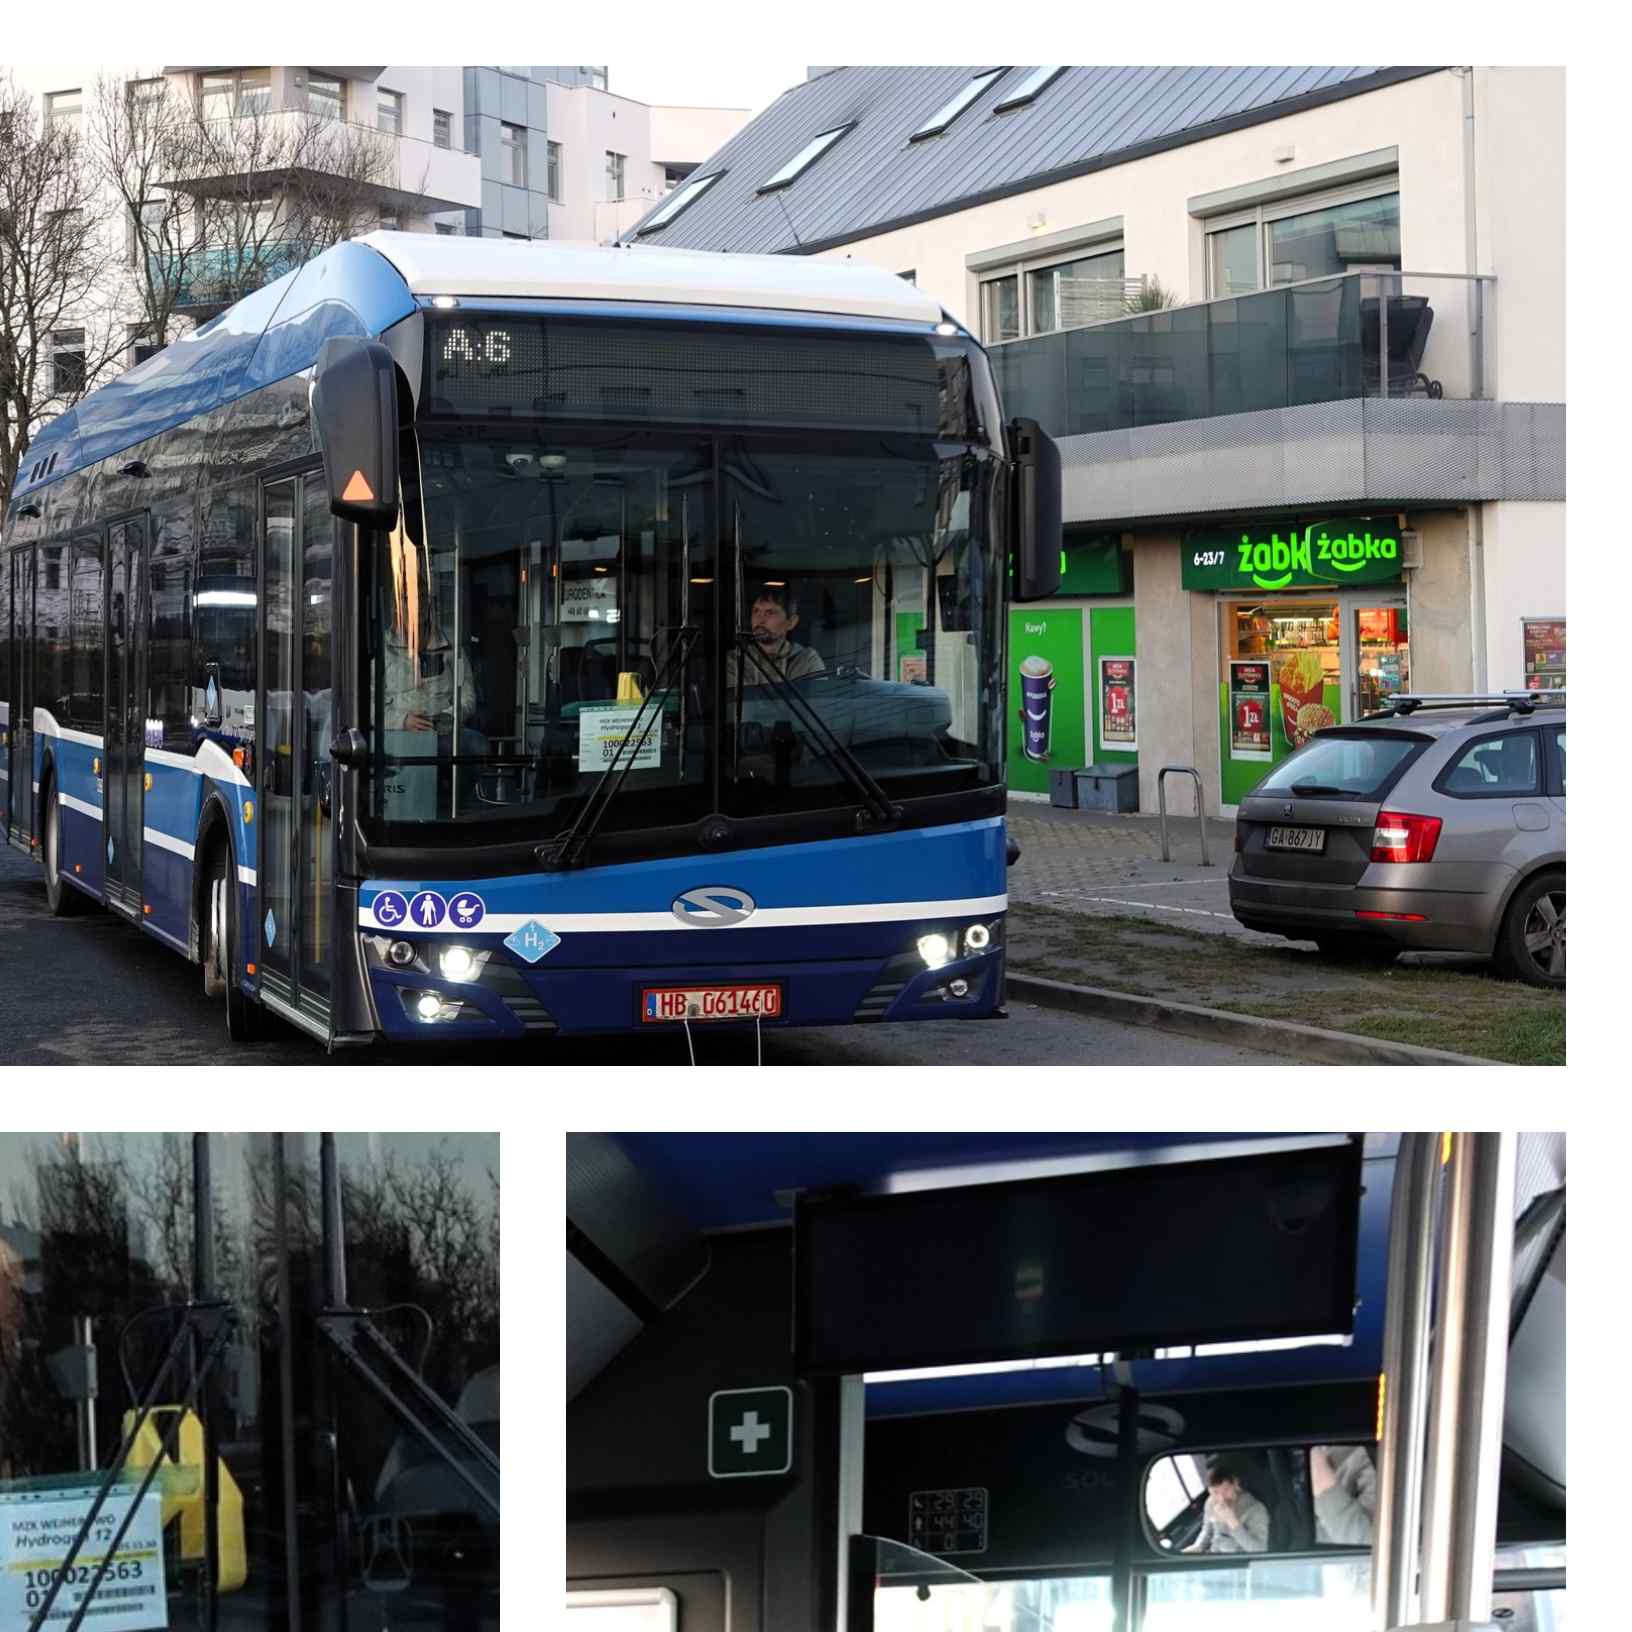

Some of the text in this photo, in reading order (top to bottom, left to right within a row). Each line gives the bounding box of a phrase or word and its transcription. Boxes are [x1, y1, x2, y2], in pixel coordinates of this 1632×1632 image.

[444, 330, 511, 361] A:6
[1193, 551, 1225, 567] 6-23/7
[1238, 534, 1307, 573] żabk
[1317, 532, 1397, 560] żabka
[661, 992, 687, 1016] HB
